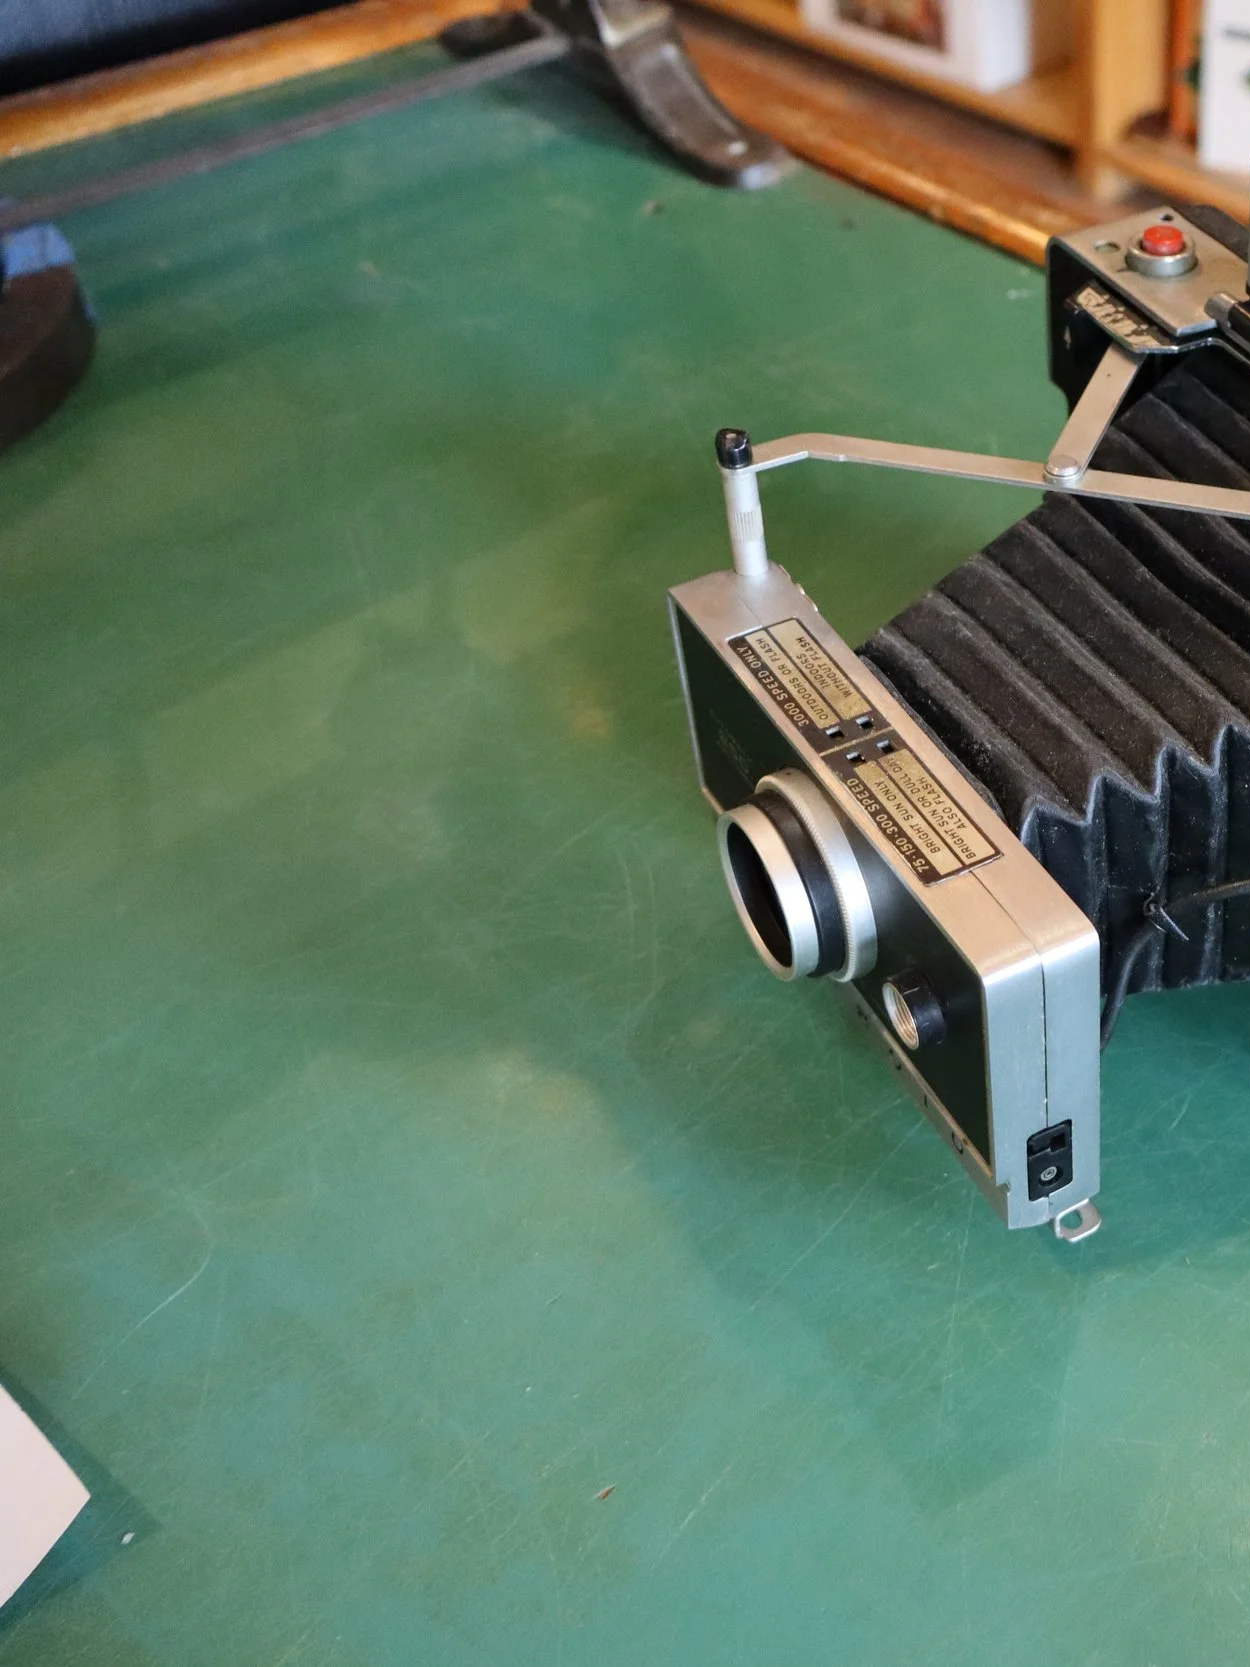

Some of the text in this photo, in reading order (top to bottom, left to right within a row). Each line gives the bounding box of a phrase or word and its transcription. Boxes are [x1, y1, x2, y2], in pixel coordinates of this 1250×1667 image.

[736, 646, 809, 726] 3000 SPEED ONLY
[756, 637, 829, 720] OUTDOORS OR FLASH
[796, 636, 853, 699] WITHOUT FLASH
[796, 652, 831, 689] INDOORS
[846, 778, 880, 812] SPEED
[899, 773, 920, 795] DULL
[917, 796, 932, 808] OR
[875, 779, 941, 854] BRIGHT SUN ONLY
[916, 777, 967, 829] ALSO FLASH
[929, 809, 949, 828] SUN
[943, 829, 976, 860] BRIGHT
